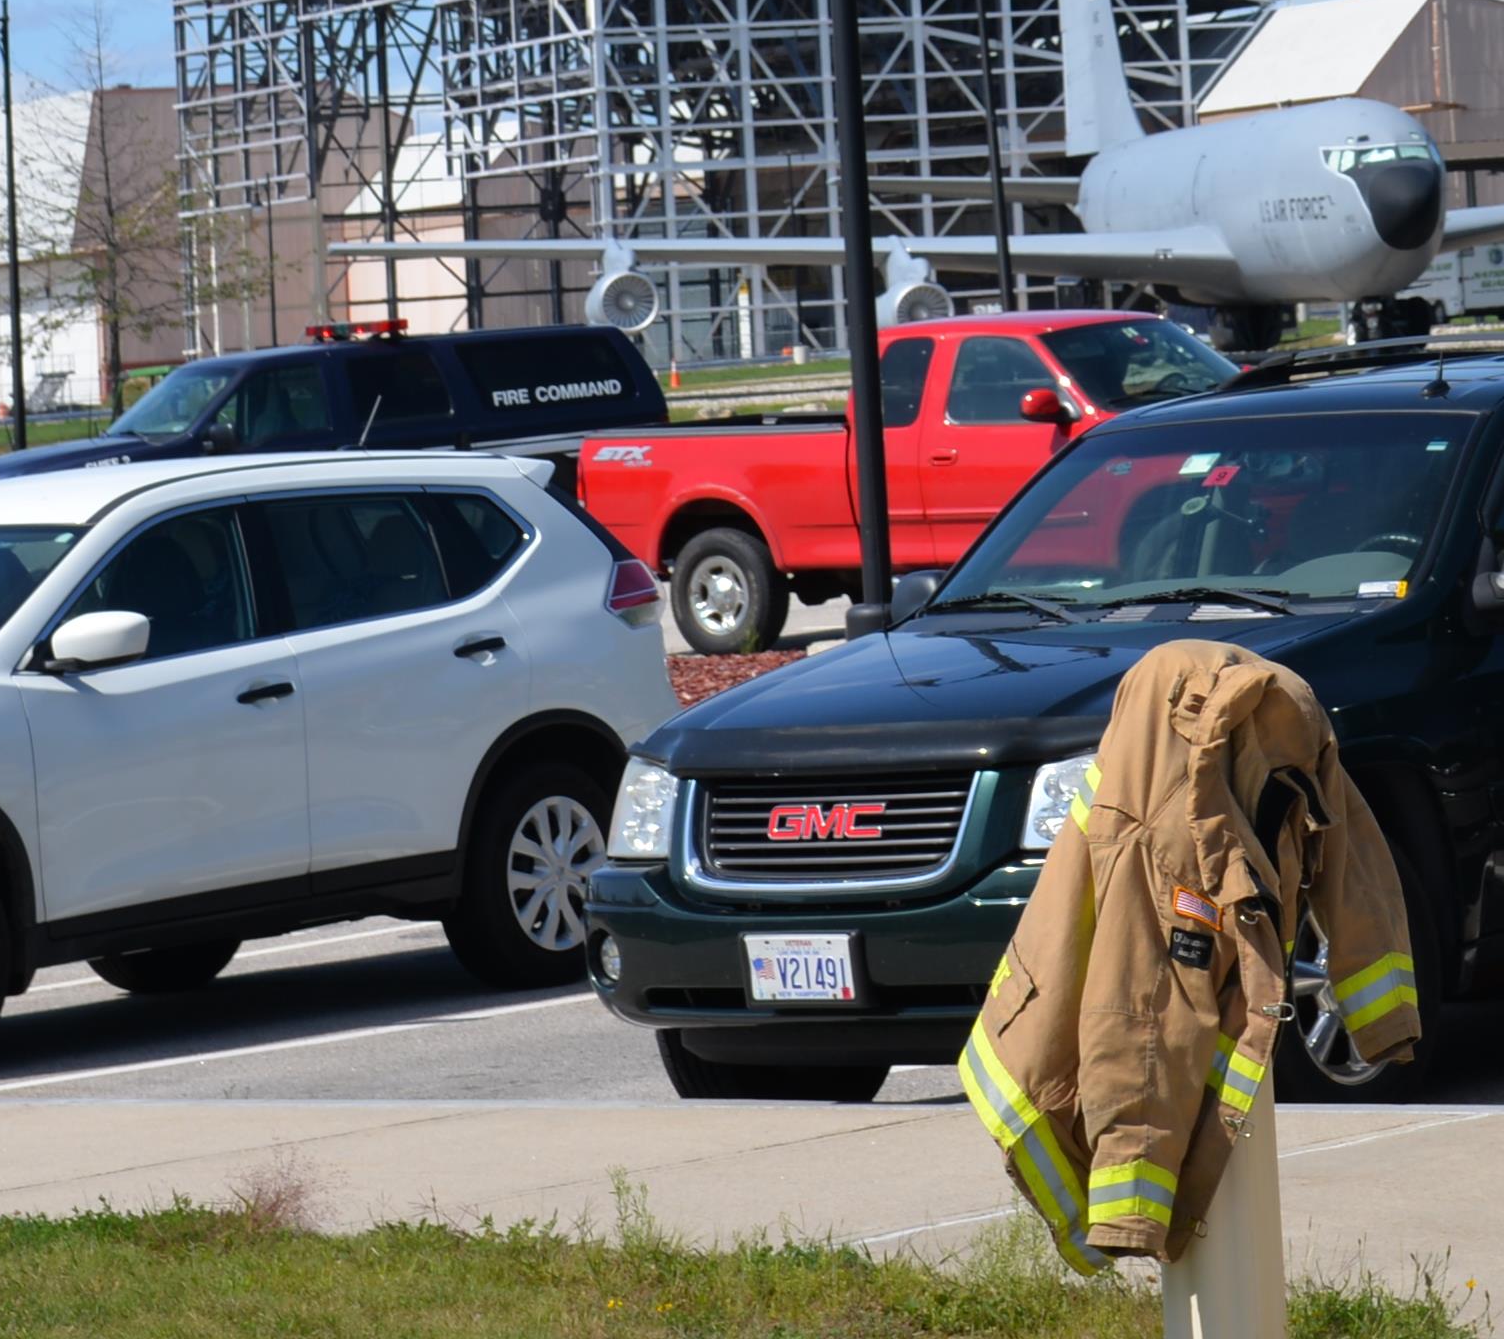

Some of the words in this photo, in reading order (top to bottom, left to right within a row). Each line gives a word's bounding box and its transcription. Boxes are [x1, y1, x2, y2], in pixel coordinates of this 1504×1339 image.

[1289, 195, 1328, 221] FORCE
[492, 389, 530, 407] FIRE
[535, 379, 622, 402] COMMAND
[592, 445, 652, 462] STX
[768, 803, 886, 840] GMC
[784, 939, 812, 947] VETERAN
[777, 957, 846, 990] V21491
